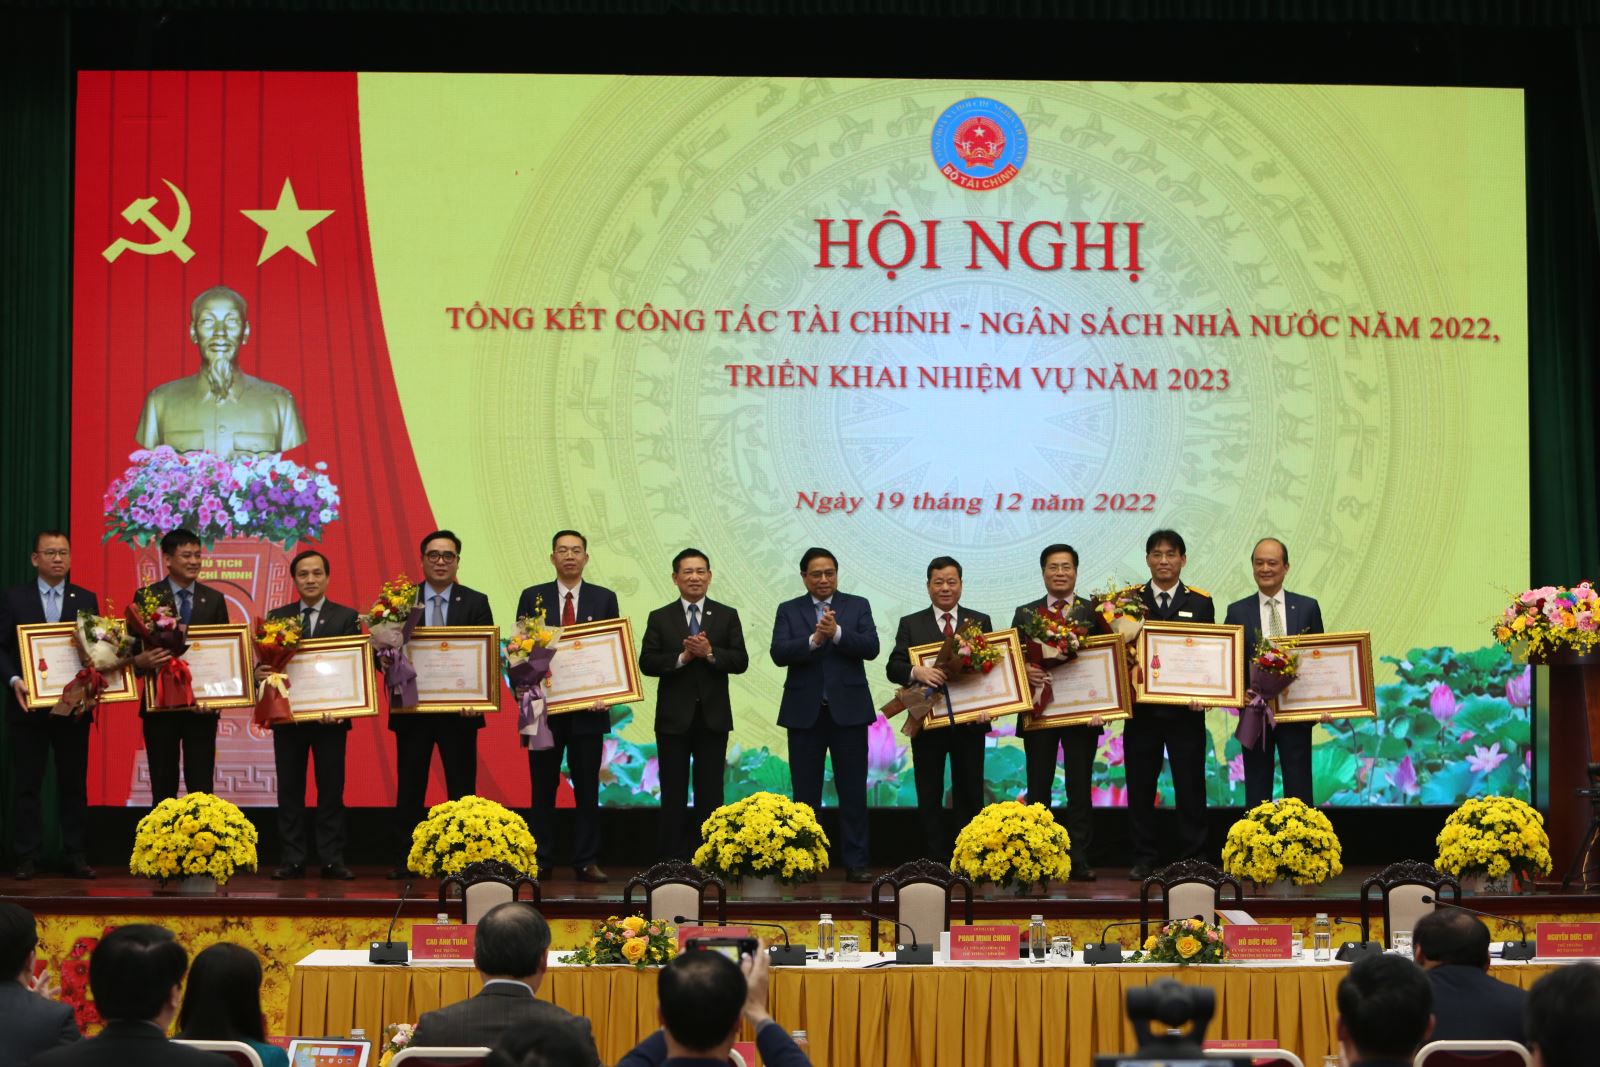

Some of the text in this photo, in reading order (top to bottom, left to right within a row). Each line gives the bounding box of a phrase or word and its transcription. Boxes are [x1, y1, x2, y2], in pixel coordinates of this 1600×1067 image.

[814, 210, 1145, 283] HỘI NGHỊ
[446, 302, 534, 330] TỔNG
[544, 302, 606, 330] KẾT
[615, 303, 704, 331] CÔNG
[715, 304, 778, 332] TÁC
[788, 304, 840, 333] TÀI
[850, 305, 950, 333] CHÍNH
[980, 306, 1071, 335] NGÂN
[1081, 307, 1164, 336] SÁCH
[1174, 308, 1240, 337] NHÀ
[1250, 309, 1339, 337] NƯỚC
[1350, 312, 1420, 339] NĂM
[1430, 317, 1500, 342] 2022,
[725, 359, 1230, 394] TRIỂN KHAI NHIỆM VỤ NĂM 2023
[796, 491, 1156, 514] Ngày 19 tháng 12 năm 2022
[221, 571, 253, 580] MINH
